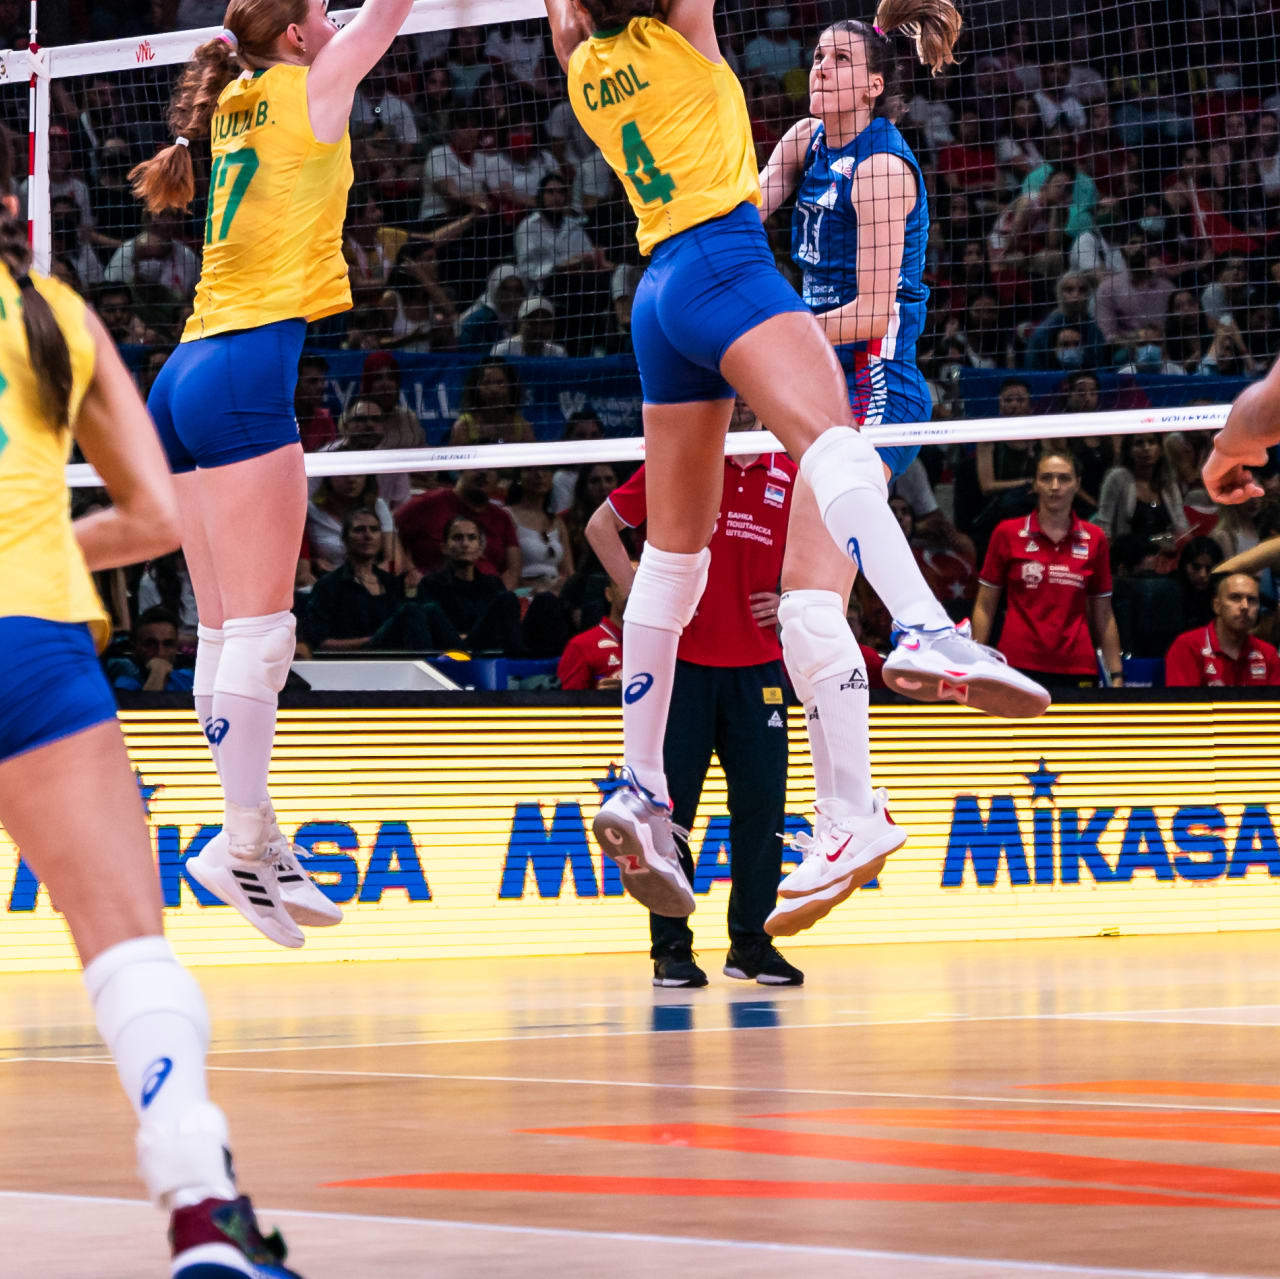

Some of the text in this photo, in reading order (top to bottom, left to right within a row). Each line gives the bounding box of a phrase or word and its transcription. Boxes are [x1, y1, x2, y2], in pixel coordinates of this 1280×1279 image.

[136, 40, 155, 63] VNL
[583, 64, 650, 111] CAROL
[622, 120, 677, 205] 4
[206, 147, 260, 245] 17
[840, 682, 867, 691] PEA
